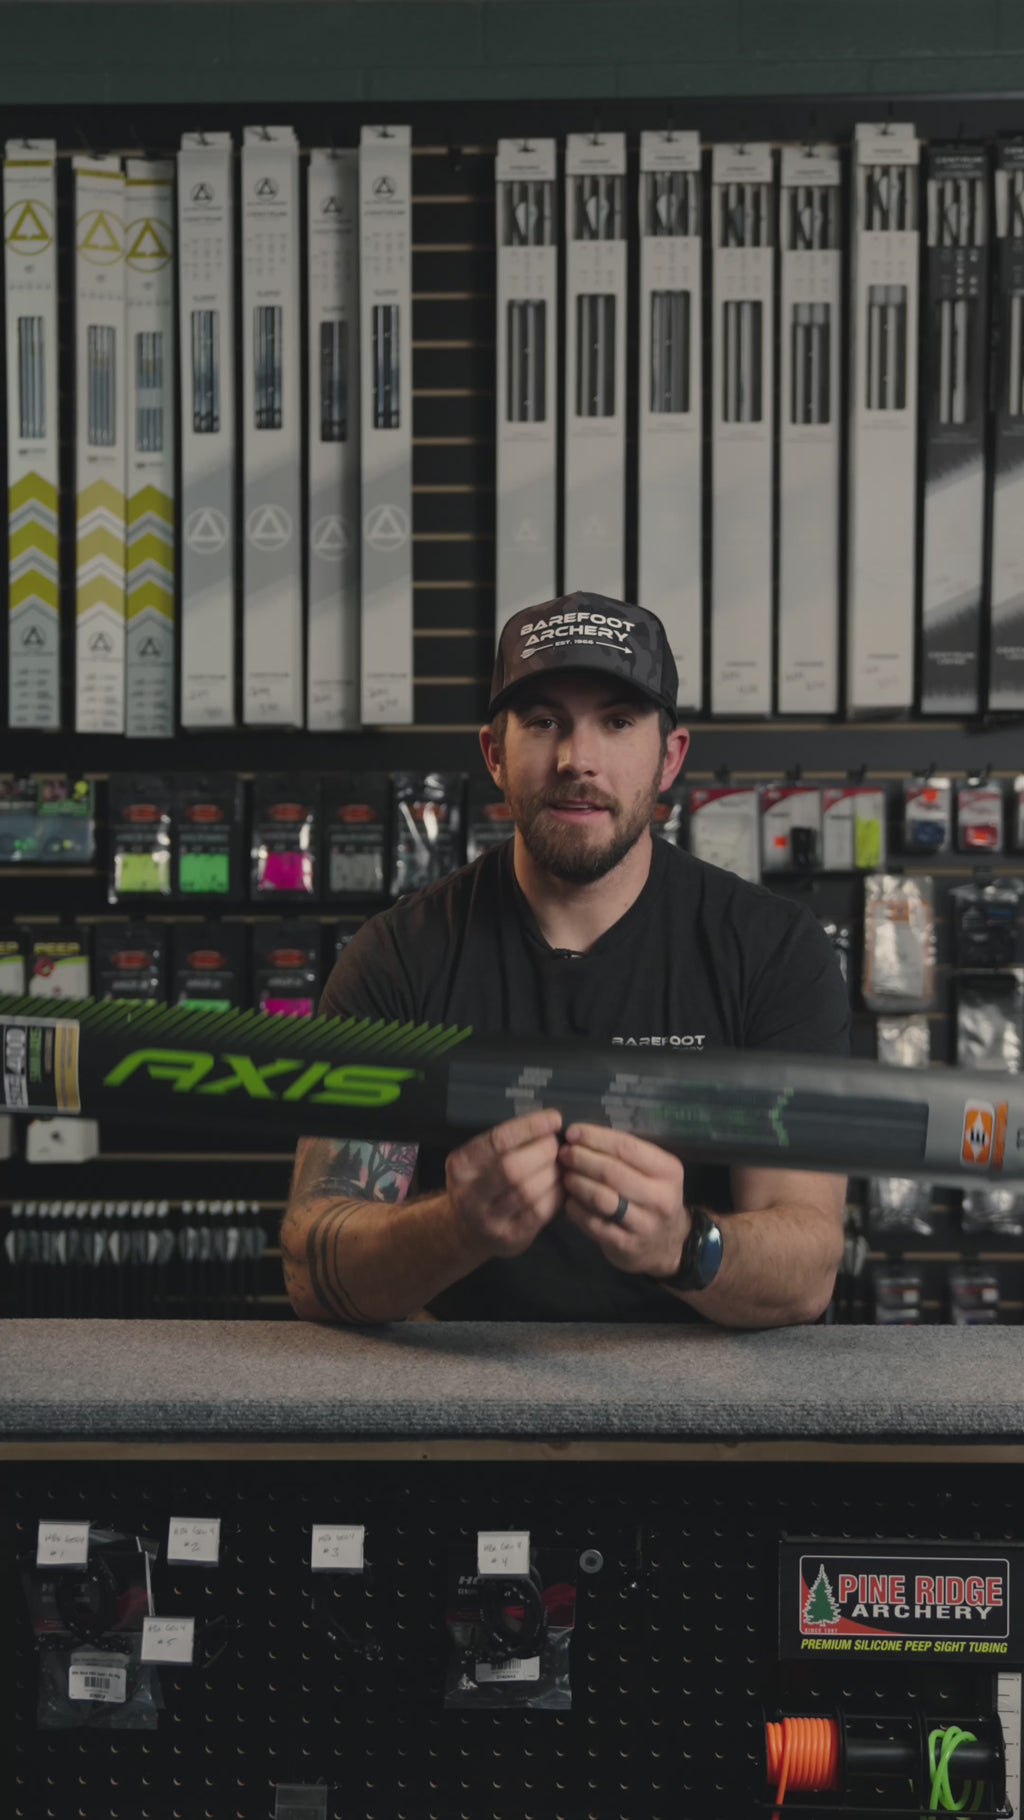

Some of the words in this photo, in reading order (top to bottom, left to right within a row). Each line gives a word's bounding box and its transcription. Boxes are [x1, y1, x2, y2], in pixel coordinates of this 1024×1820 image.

[520, 611, 636, 637] BAREFOOT
[525, 624, 629, 647] ARCHERY
[554, 639, 573, 647] EST.
[103, 1047, 417, 1108] AXIS
[838, 1574, 906, 1605] PINE
[915, 1575, 1003, 1607] RIDGE
[851, 1604, 993, 1621] ARCHERY
[801, 1638, 852, 1650] PREMIUM
[854, 1639, 902, 1652] SILICONE
[904, 1640, 932, 1652] PEEP
[934, 1641, 966, 1653] SIGHT
[968, 1642, 1008, 1654] TUBING
